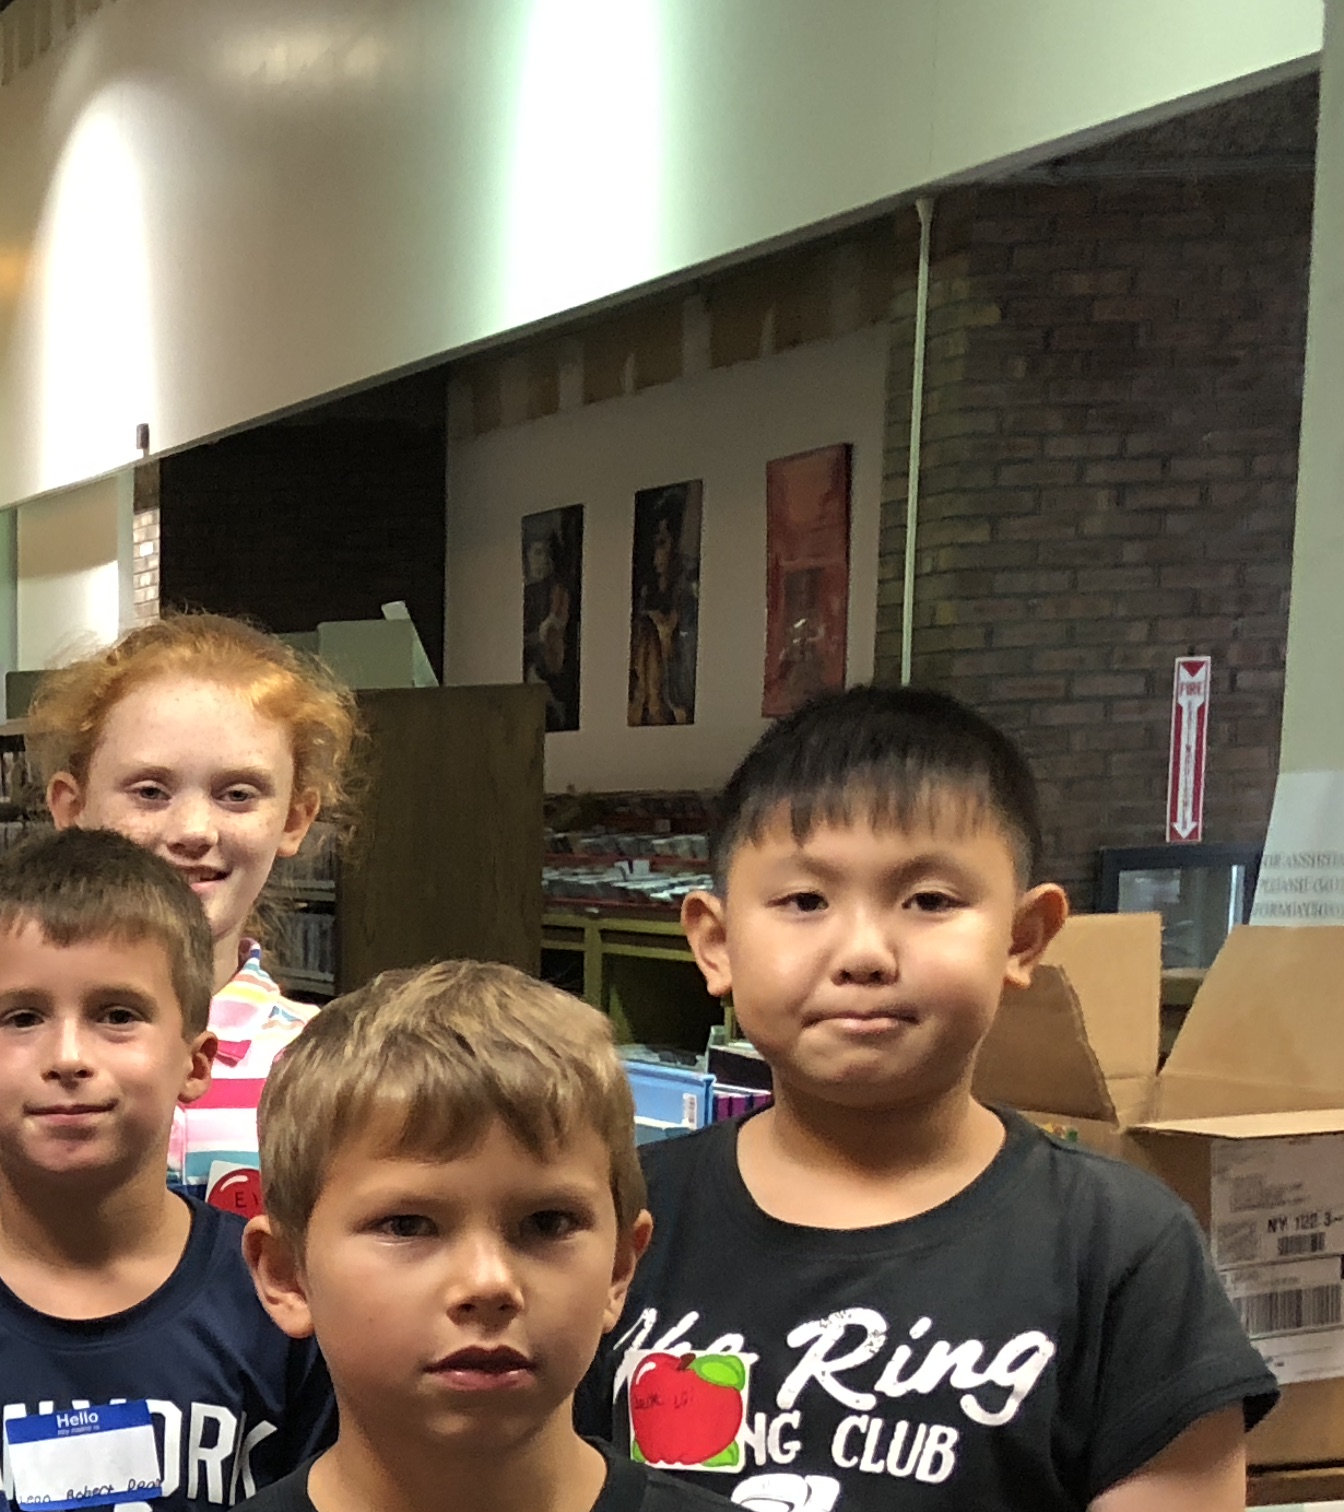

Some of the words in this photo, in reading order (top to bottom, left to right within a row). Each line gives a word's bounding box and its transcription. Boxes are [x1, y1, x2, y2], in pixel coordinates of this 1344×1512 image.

[1179, 681, 1204, 697] FIRE
[776, 1307, 1056, 1426] Ring
[56, 1411, 99, 1428] Hello
[832, 1416, 960, 1483] CLUB
